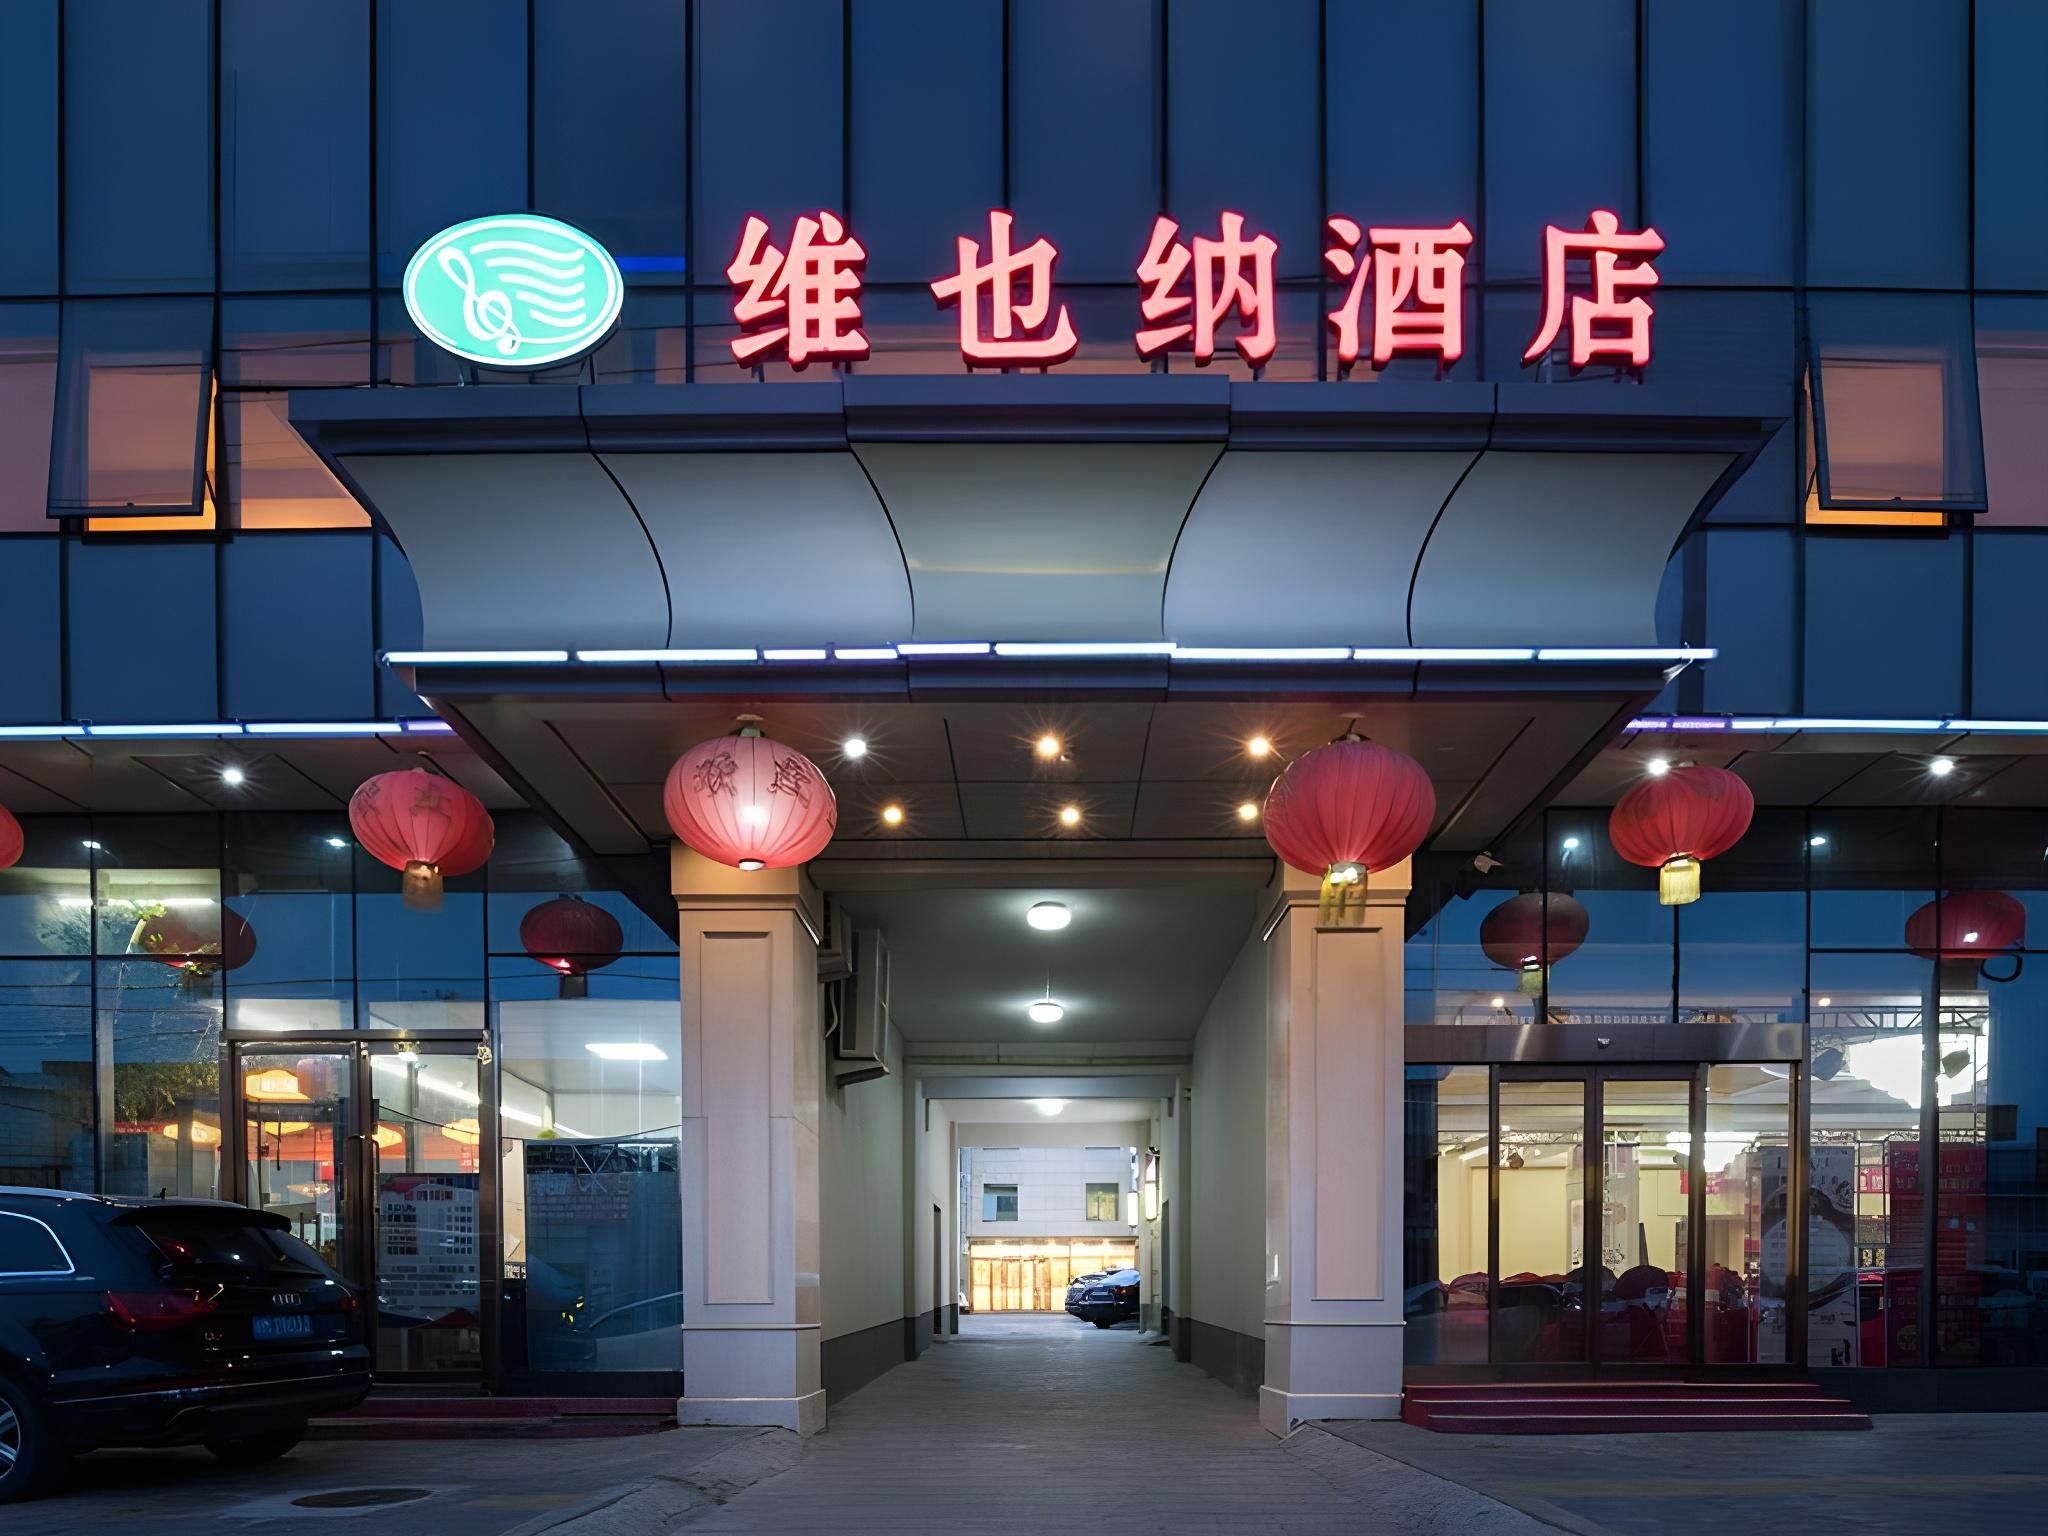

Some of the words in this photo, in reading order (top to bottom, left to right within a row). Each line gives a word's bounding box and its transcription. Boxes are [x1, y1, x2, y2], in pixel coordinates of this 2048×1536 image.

[727, 209, 1666, 370] 维也纳酒店
